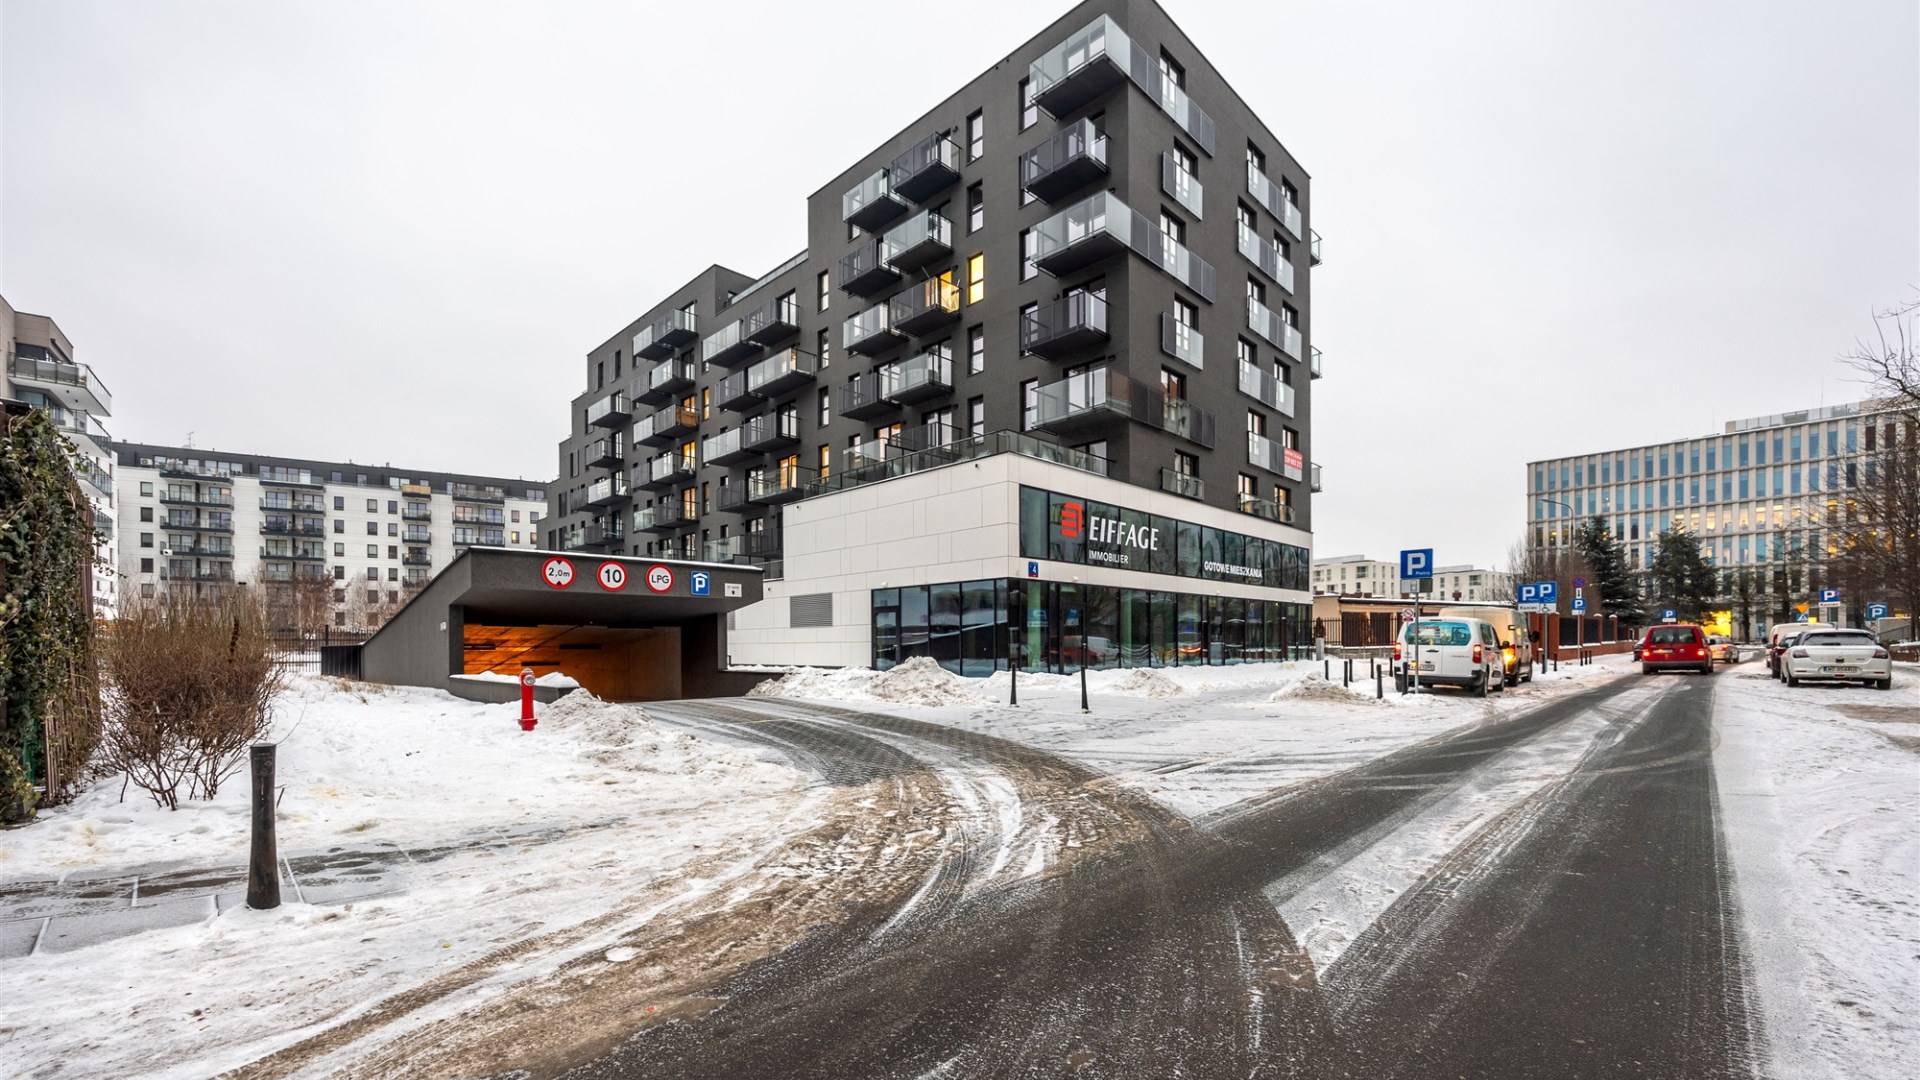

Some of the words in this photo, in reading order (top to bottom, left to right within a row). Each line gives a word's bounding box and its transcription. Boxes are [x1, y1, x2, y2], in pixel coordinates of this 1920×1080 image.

[1089, 516, 1159, 551] EIFFAGE
[1089, 550, 1129, 564] IMMOBILIER
[1032, 565, 1037, 574] 4
[1204, 560, 1230, 574] GOTOWE
[1230, 565, 1263, 578] MIESZKANIA
[1407, 553, 1426, 576] P
[548, 567, 570, 577] 2,0m
[604, 568, 622, 583] 10
[651, 574, 669, 584] LPG
[695, 577, 706, 592] P
[1522, 586, 1535, 601] P
[1540, 584, 1552, 597] P
[1824, 590, 1836, 601] P
[1574, 600, 1583, 609] P
[1872, 608, 1883, 618] P
